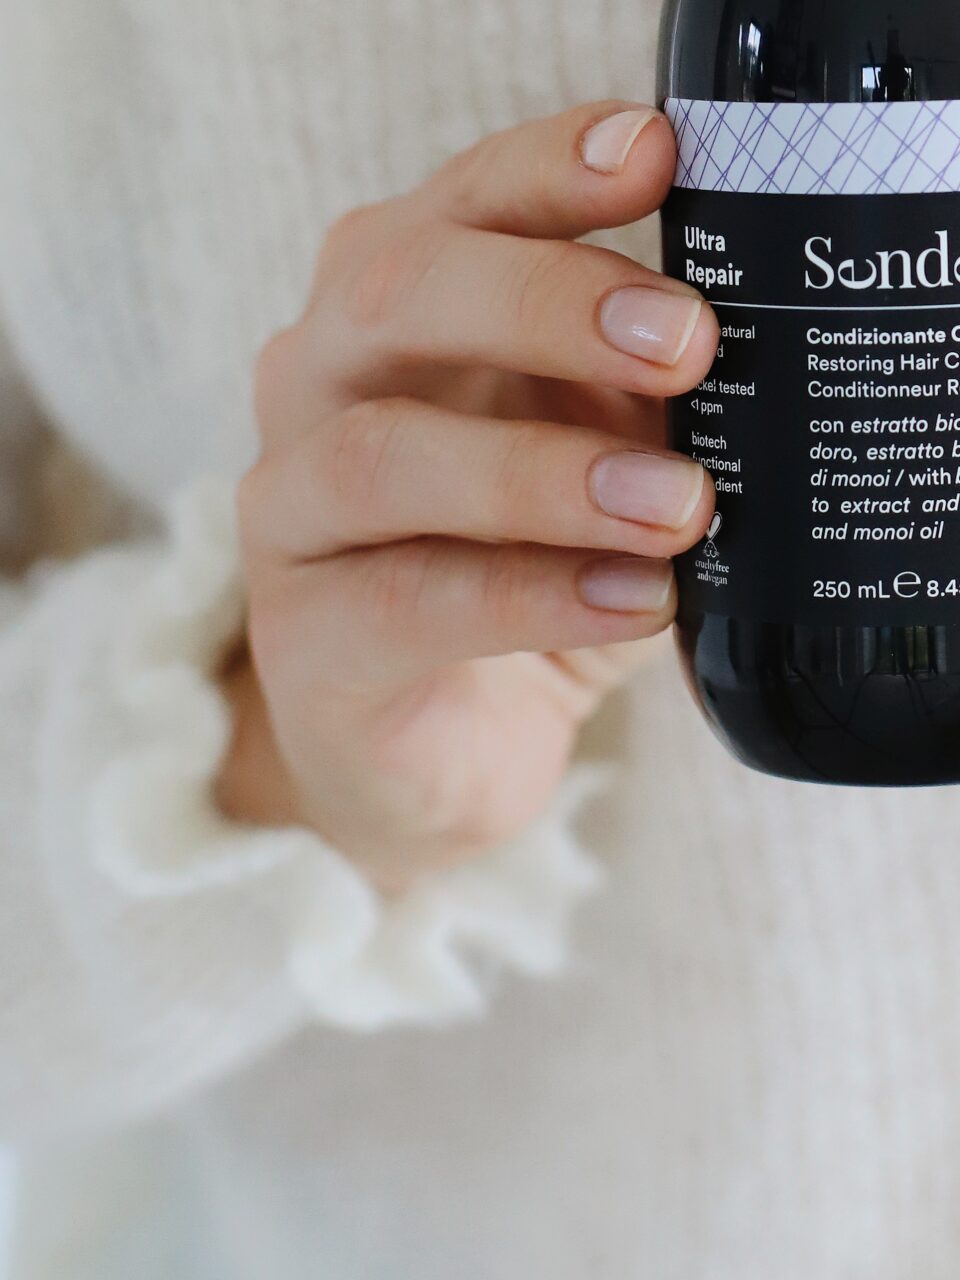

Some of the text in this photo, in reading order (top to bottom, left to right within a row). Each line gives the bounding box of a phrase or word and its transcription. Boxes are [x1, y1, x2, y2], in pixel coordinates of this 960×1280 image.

[685, 225, 726, 252] Ultra
[686, 259, 743, 288] Repair
[720, 324, 755, 339] atural
[806, 327, 947, 345] Condizionante
[807, 354, 894, 375] Restoring
[901, 353, 939, 370] Hair
[719, 381, 755, 396] tested
[808, 381, 941, 398] Conditionneur
[701, 402, 723, 415] ppm
[809, 420, 844, 433] con
[850, 416, 929, 433] estratto
[692, 431, 727, 450] biotech
[809, 441, 858, 463] doro,
[866, 442, 944, 460] estratto
[715, 477, 743, 493] dient
[810, 469, 828, 486] di
[831, 469, 891, 487] monoi
[894, 469, 905, 487] /
[908, 467, 952, 486] with
[811, 497, 830, 513] to
[840, 497, 911, 514] extract
[921, 493, 960, 513] and
[811, 521, 944, 540] and monoi oil
[813, 580, 851, 598] 250
[858, 580, 890, 599] mL
